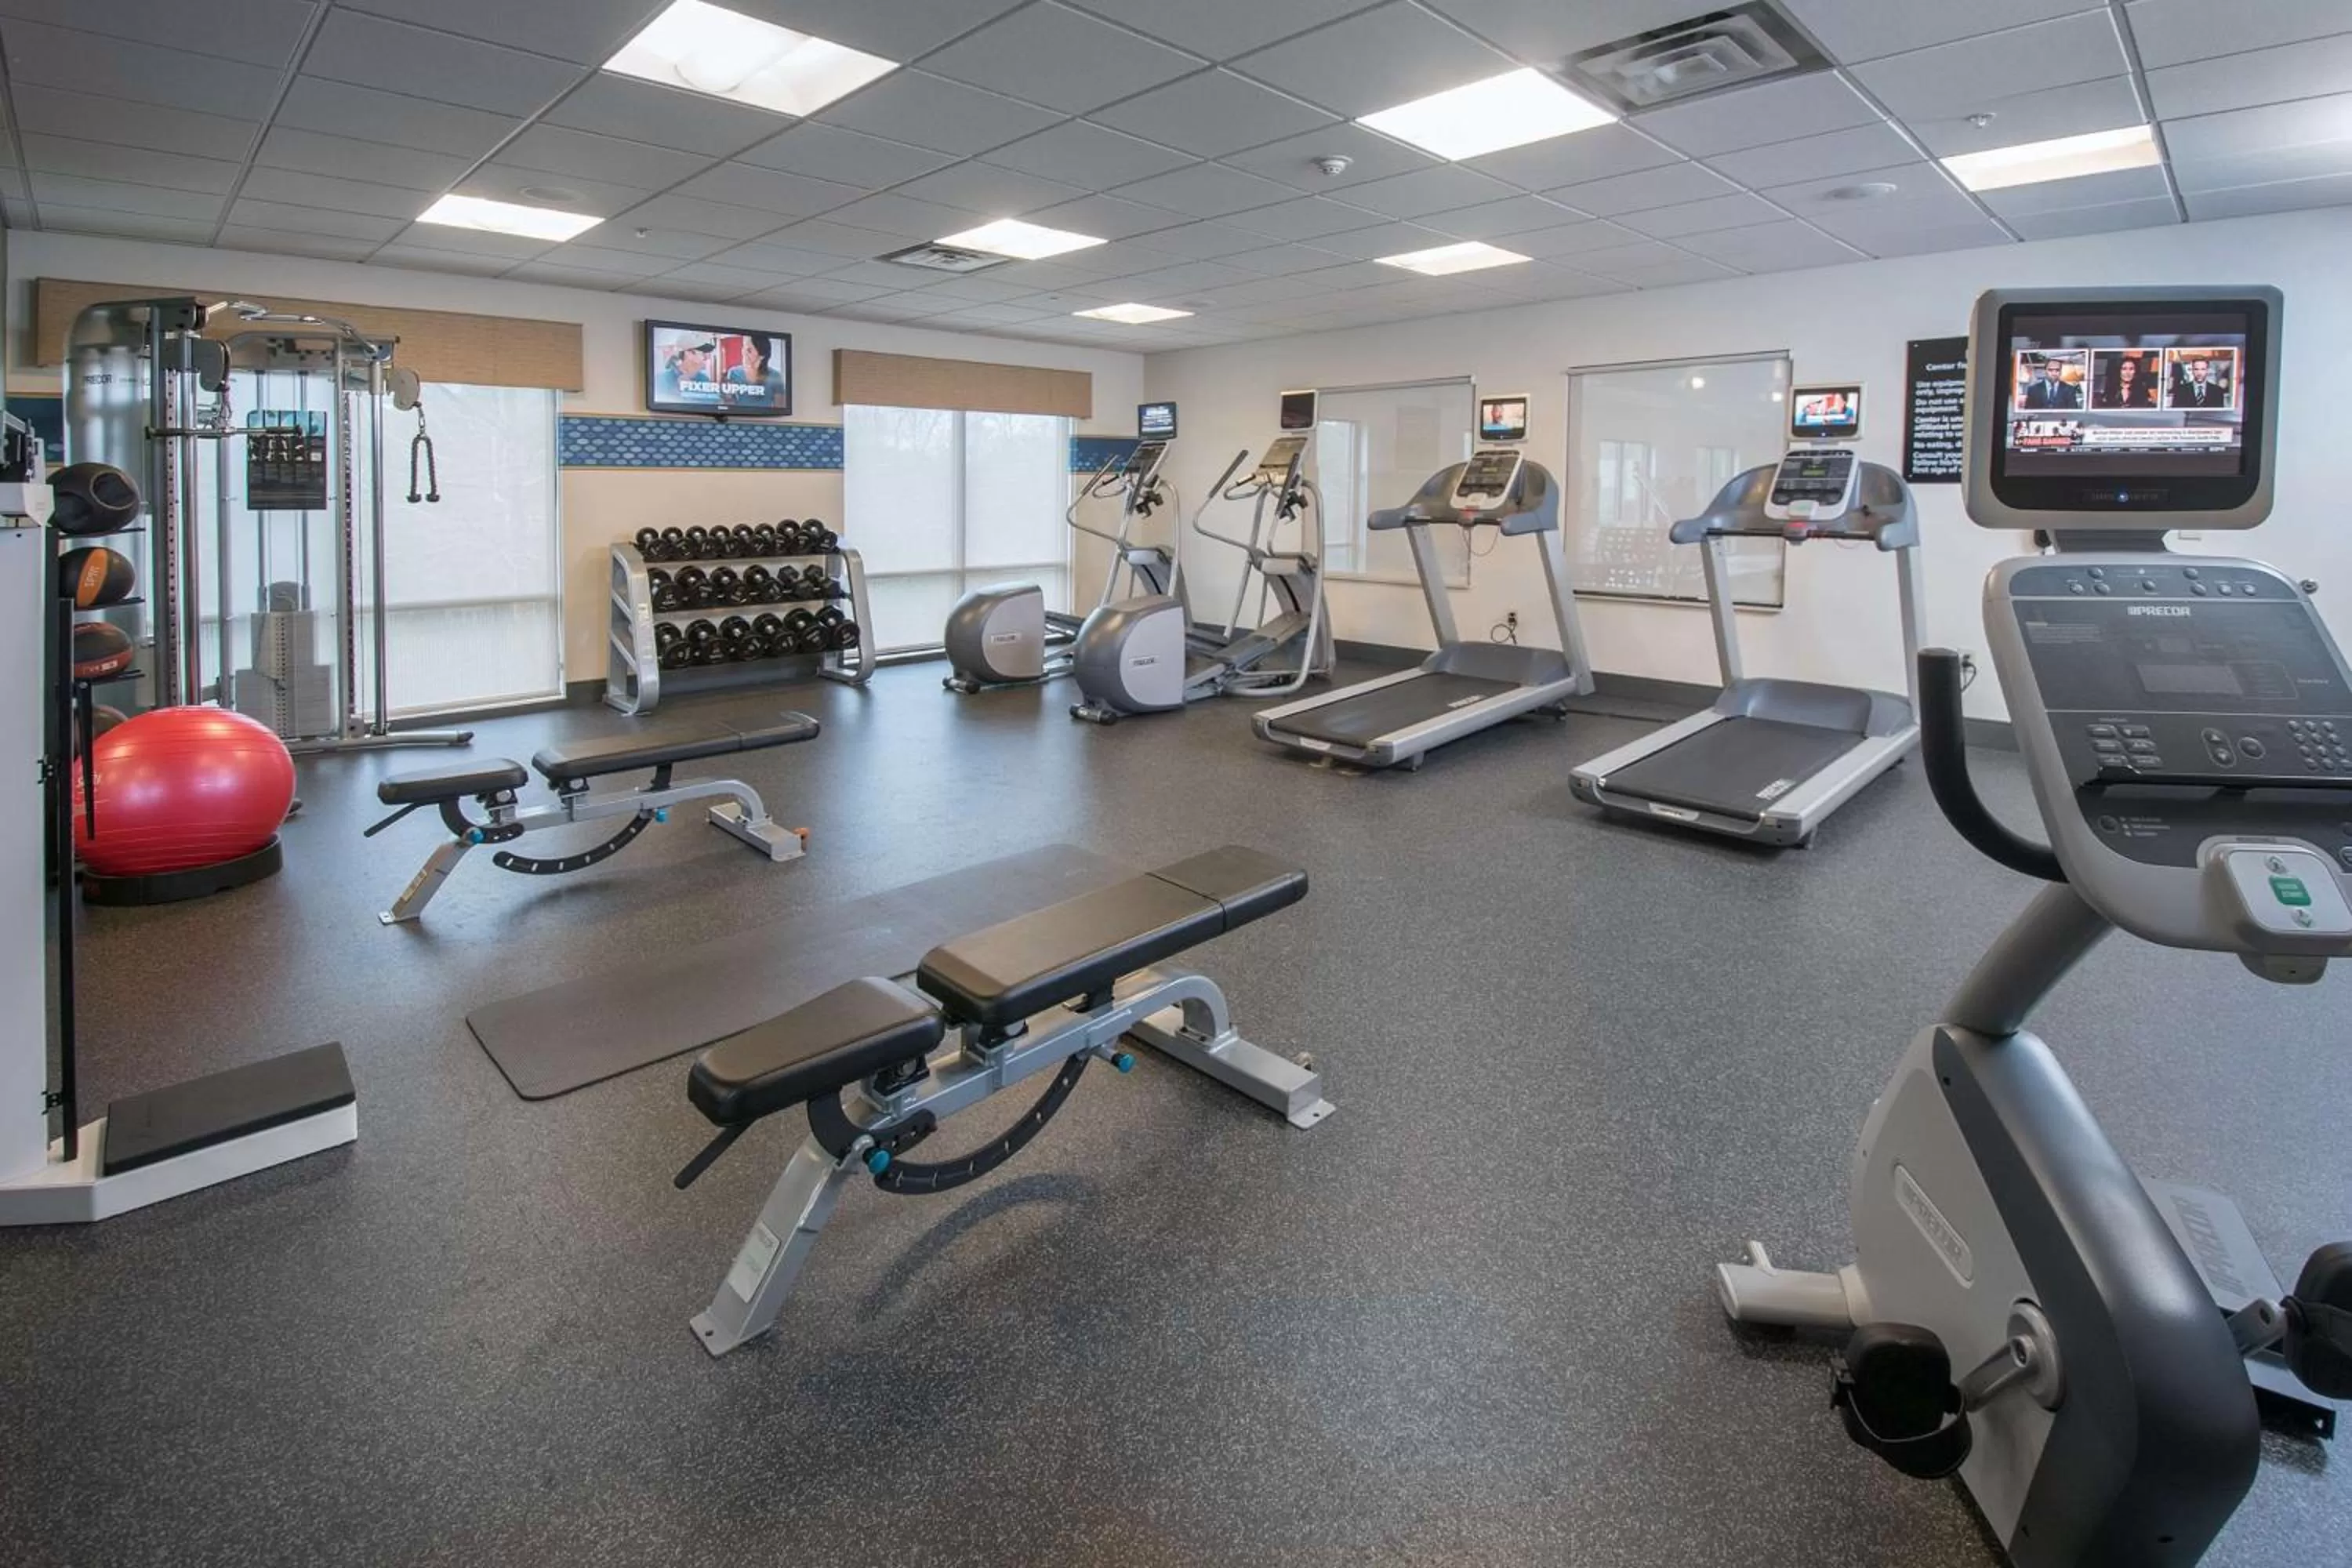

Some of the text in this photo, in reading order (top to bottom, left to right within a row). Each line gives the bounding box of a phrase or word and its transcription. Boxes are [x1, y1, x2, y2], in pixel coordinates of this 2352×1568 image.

[679, 380, 765, 396] FIXER UPPER
[2137, 605, 2192, 616] PRECOR
